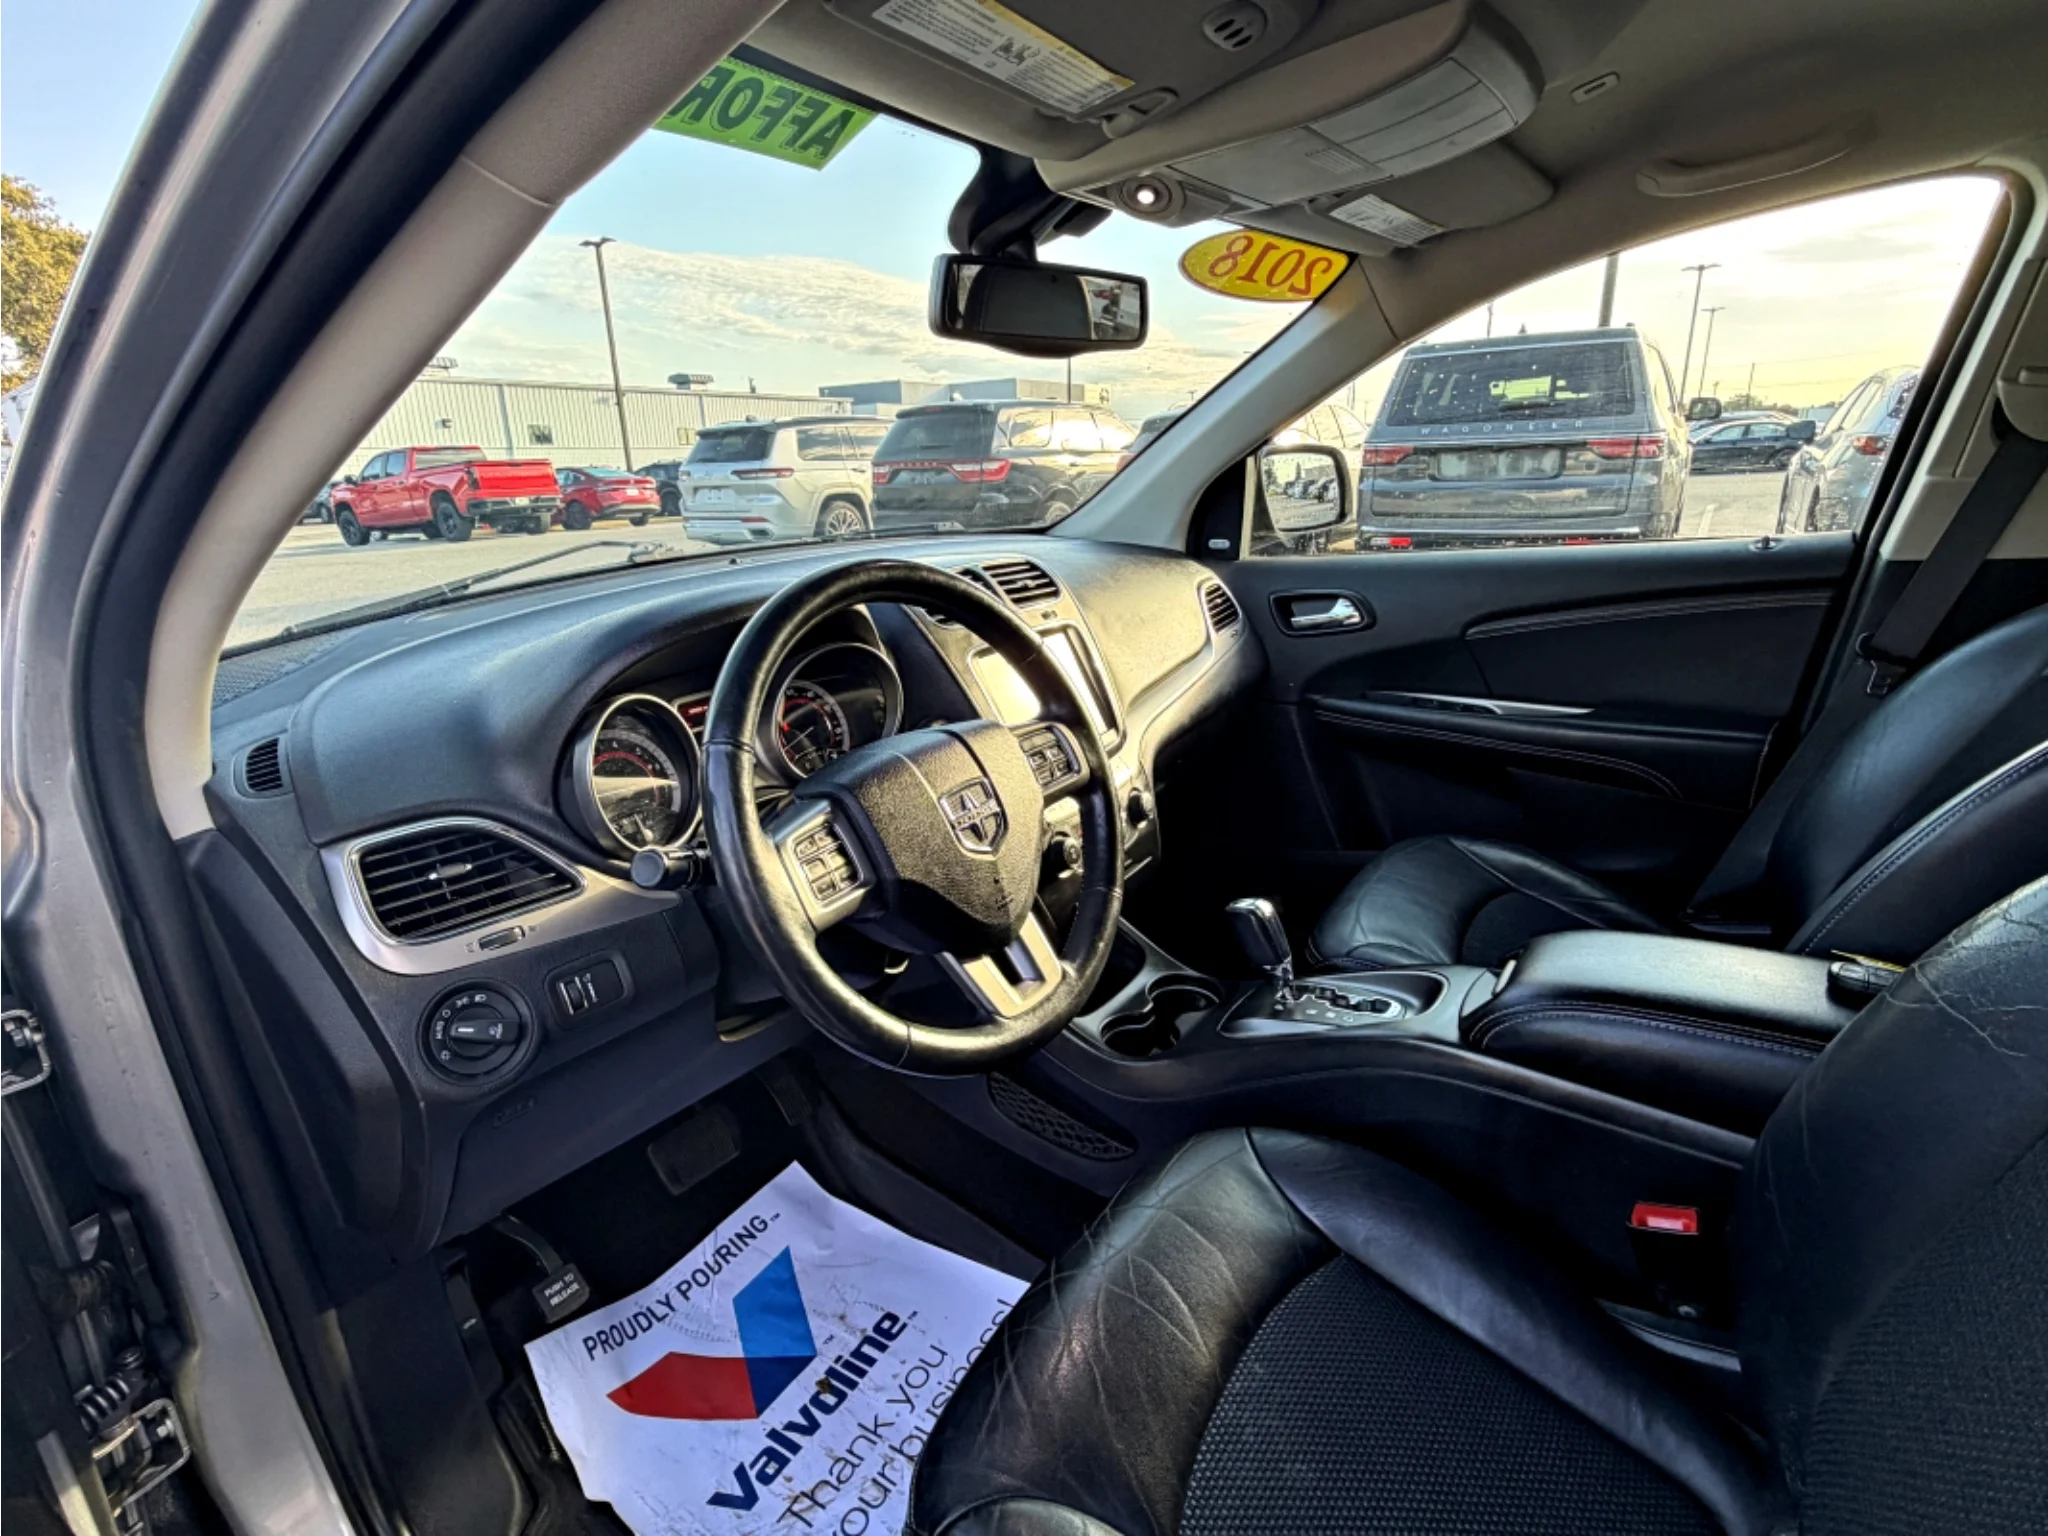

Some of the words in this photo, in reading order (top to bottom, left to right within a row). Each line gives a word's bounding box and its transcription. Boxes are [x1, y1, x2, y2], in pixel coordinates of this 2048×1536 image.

[1421, 420, 1583, 436] WAGONEER
[582, 1294, 677, 1361] PROUDLY
[775, 1413, 895, 1529] Thank
[885, 1343, 949, 1415] you
[832, 1457, 898, 1536] our
